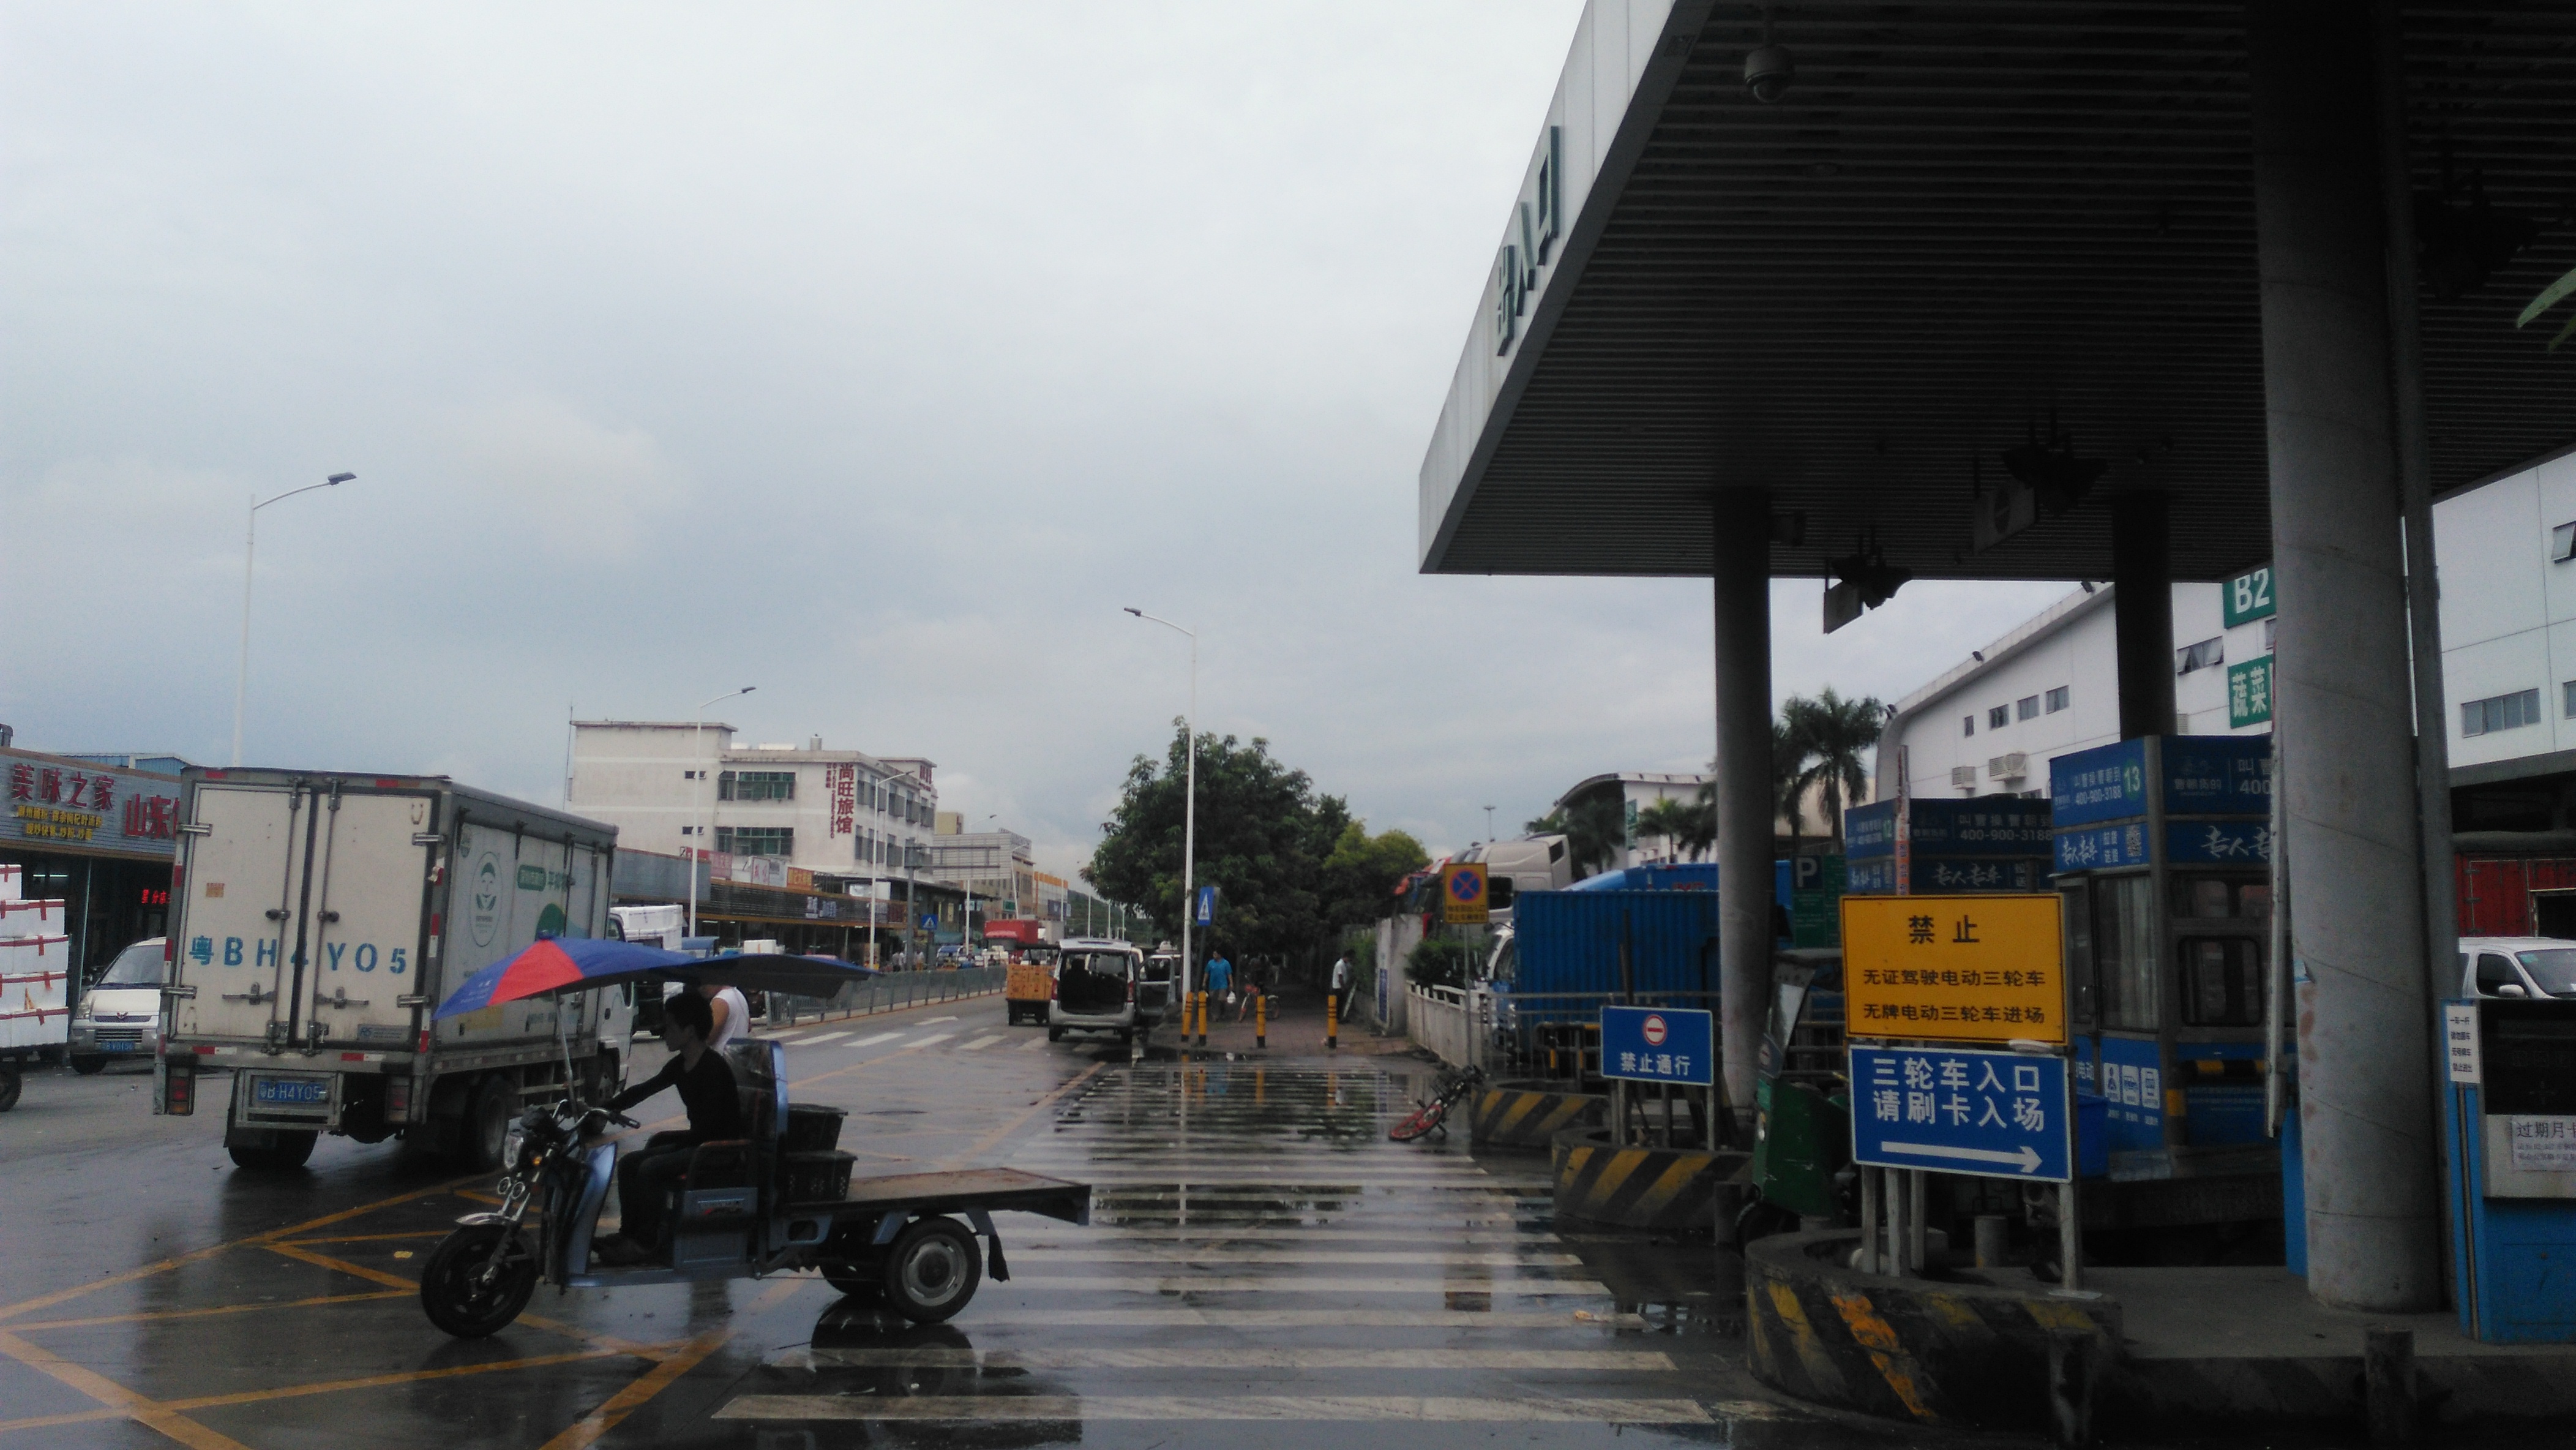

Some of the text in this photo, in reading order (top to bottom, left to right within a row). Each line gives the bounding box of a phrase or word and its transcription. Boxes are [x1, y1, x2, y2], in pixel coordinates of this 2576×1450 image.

[2234, 568, 2271, 614] B2
[2232, 663, 2273, 718] 蔬菜
[12, 763, 116, 811] 美味之家
[2076, 784, 2122, 806] 400-900-3188
[2124, 766, 2141, 793] 13
[836, 763, 855, 833] 尚旺旅馆
[125, 794, 179, 840] 山东
[1961, 829, 2053, 841] 400-900-3188
[1796, 857, 1818, 888] P
[1909, 915, 1980, 945] 禁止
[1863, 969, 2045, 987] 无证驾驶电动三轮车
[1863, 1004, 2045, 1024] 无牌电动三轮车进场
[1620, 1051, 1691, 1076] 禁止通行
[1873, 1057, 2040, 1094] 三轮车入口
[1873, 1089, 2045, 1133] 请刷卡入场
